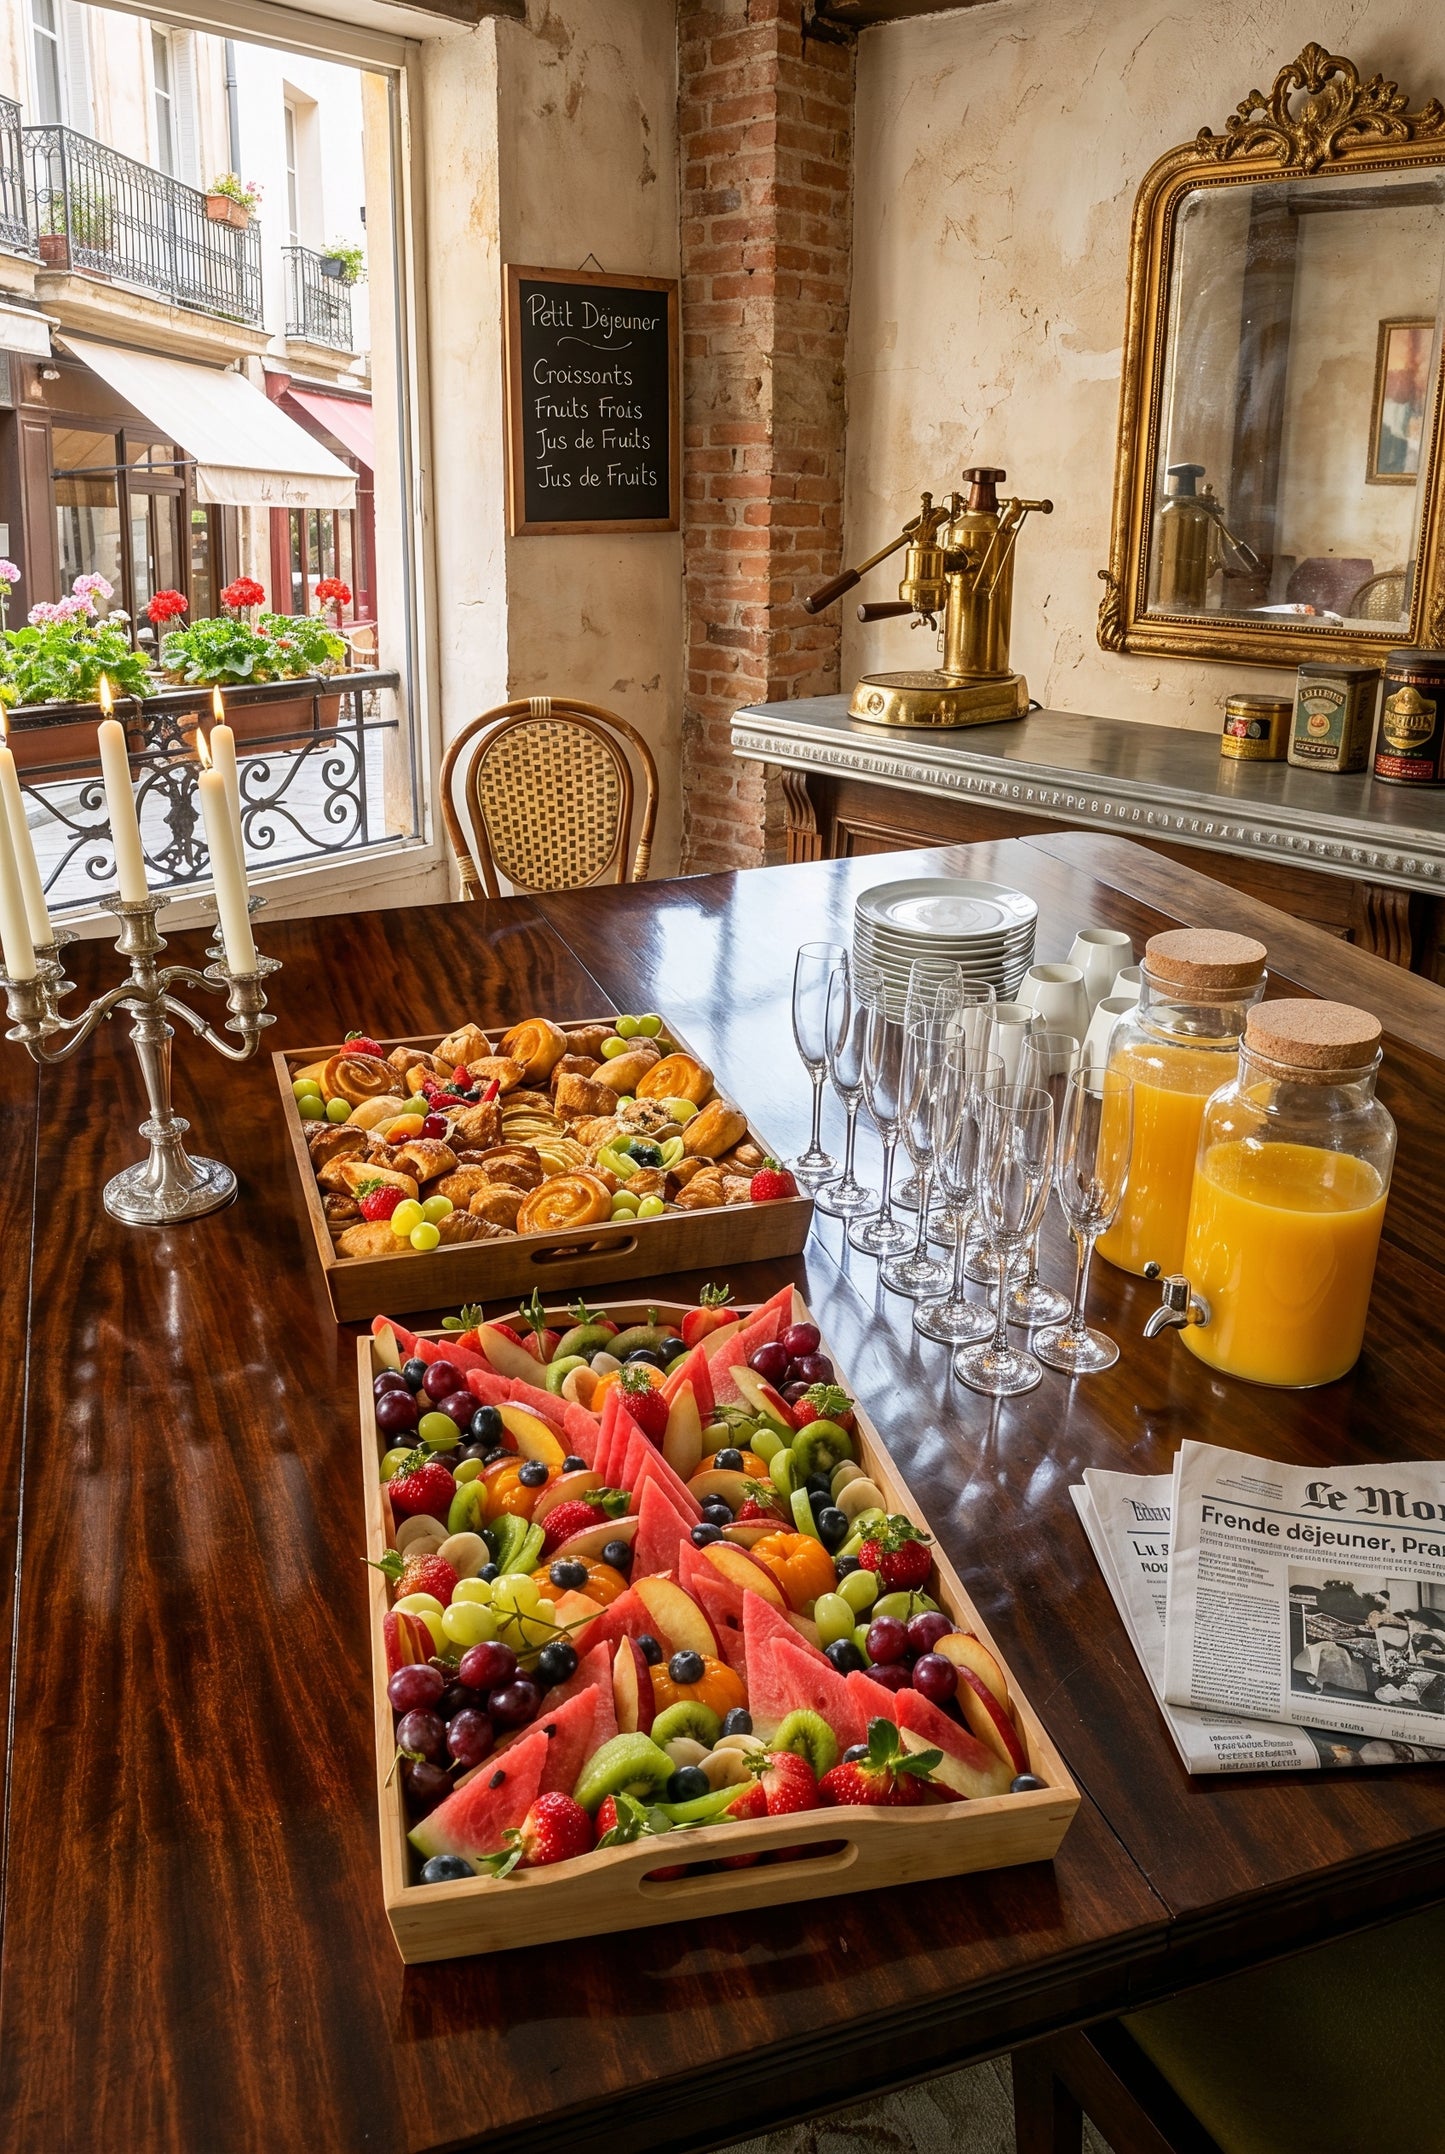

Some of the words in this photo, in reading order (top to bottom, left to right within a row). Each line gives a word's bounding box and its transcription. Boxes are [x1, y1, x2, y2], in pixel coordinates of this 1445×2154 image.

[526, 293, 574, 327] Petit
[536, 428, 568, 459] Jus
[574, 428, 595, 449] de
[602, 427, 651, 450] Fruits
[536, 464, 572, 488] Jus
[579, 466, 602, 487] de
[607, 462, 658, 487] Fruits
[1300, 1481, 1349, 1512] Le
[1201, 1504, 1280, 1537] Frende
[1402, 1535, 1445, 1557] Pra
